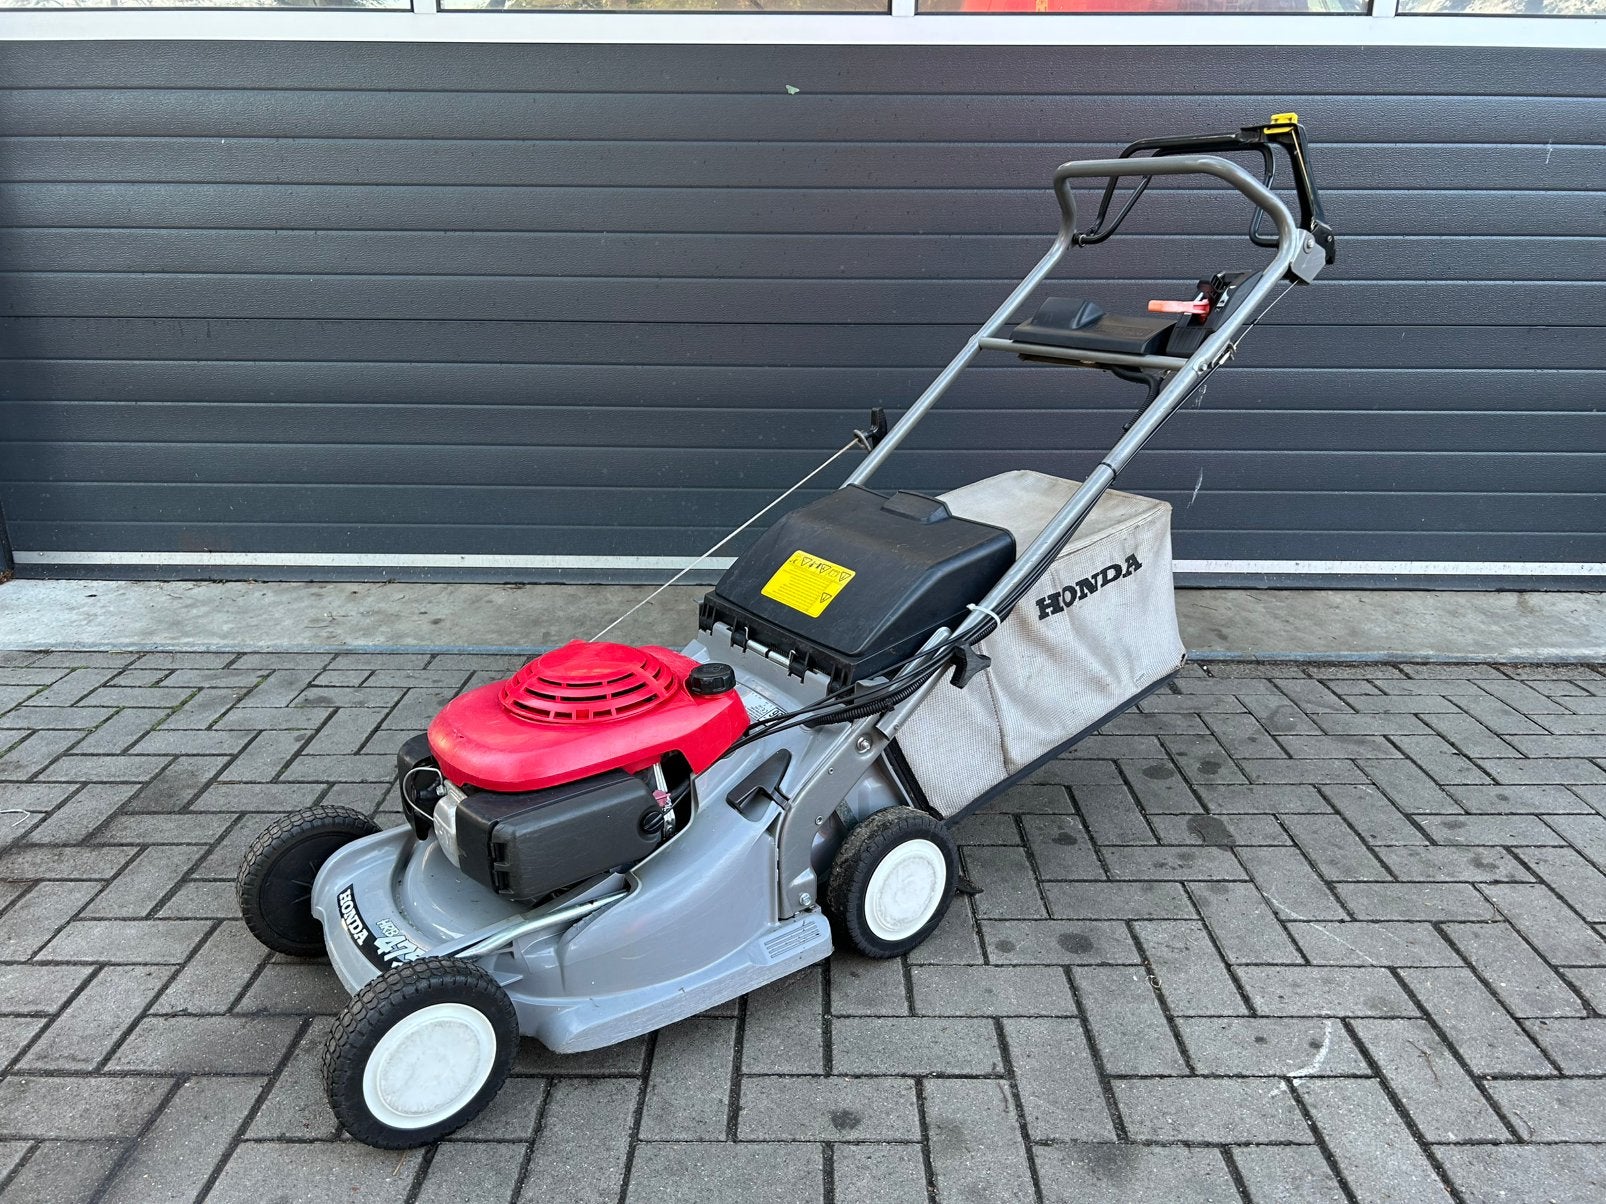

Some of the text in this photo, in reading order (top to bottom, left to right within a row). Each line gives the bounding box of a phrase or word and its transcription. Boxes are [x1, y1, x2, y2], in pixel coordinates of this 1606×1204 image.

[1035, 553, 1142, 620] HONDA
[339, 888, 369, 946] HONDA
[376, 919, 400, 937] HRB
